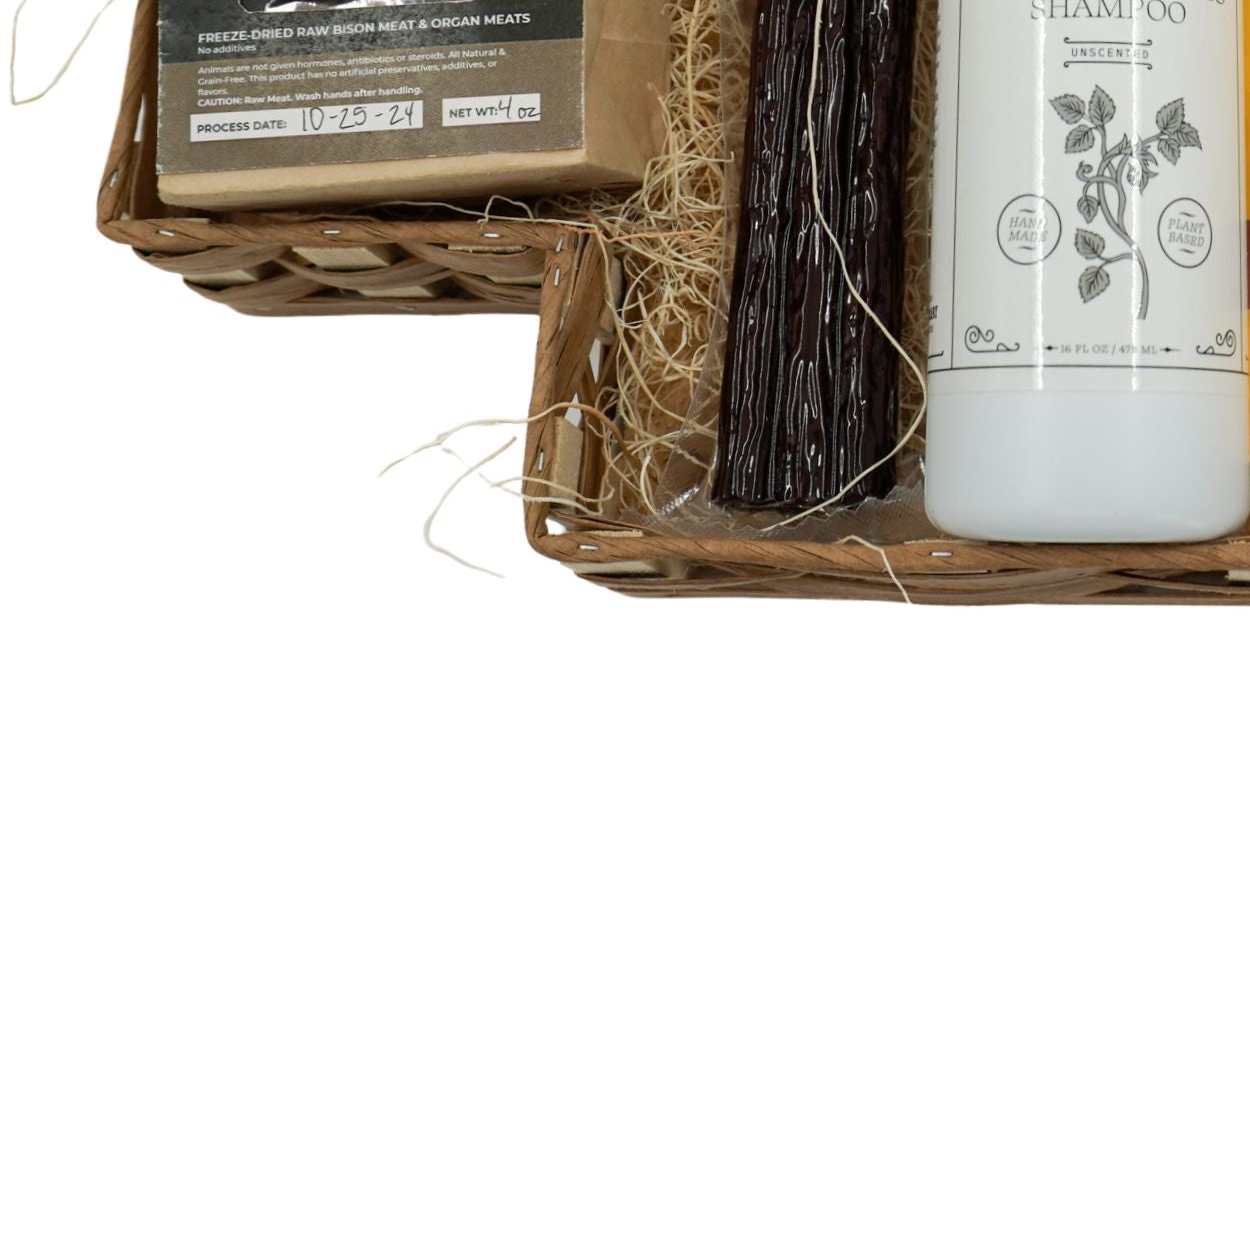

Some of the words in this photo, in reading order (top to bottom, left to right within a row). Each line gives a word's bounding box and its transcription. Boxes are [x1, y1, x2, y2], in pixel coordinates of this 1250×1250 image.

[198, 27, 294, 44] FREEZE-DRIED
[297, 25, 330, 38] RAW
[333, 22, 375, 35] BISON
[378, 19, 416, 32] MEAT
[418, 18, 428, 30] &
[431, 15, 481, 29] ORGAN
[484, 12, 532, 26] MEATS
[198, 46, 212, 55] No
[213, 43, 257, 54] additives
[1071, 47, 1150, 59] UNSCENTED
[198, 65, 235, 75] Animals
[236, 65, 251, 73] are
[252, 63, 269, 72] not
[270, 61, 295, 72] given
[347, 54, 395, 65] antibiotics
[396, 55, 407, 63] or
[448, 49, 461, 59] All
[462, 48, 497, 58] Natural
[498, 47, 506, 56] &
[249, 74, 267, 83] This
[269, 72, 305, 84] product
[307, 70, 323, 79] has
[326, 70, 338, 78] no
[339, 66, 377, 77] artificial
[488, 59, 497, 68] or
[198, 96, 243, 107] CAUTION:
[244, 95, 265, 104] Raw
[295, 92, 321, 101] Wash
[323, 89, 353, 100] hands
[354, 87, 377, 98] after
[449, 107, 473, 119] NET
[475, 106, 498, 117] WT:
[498, 96, 513, 119] 4
[302, 102, 414, 132] 10-25-24
[197, 121, 250, 134] PROCESS
[253, 119, 288, 131] DATE:
[1168, 218, 1206, 235] PLANT
[1168, 231, 1206, 248] BASED
[1060, 344, 1072, 354] 16
[1075, 344, 1089, 354] FL
[1091, 344, 1109, 355] OZ
[1141, 345, 1158, 355] ML
